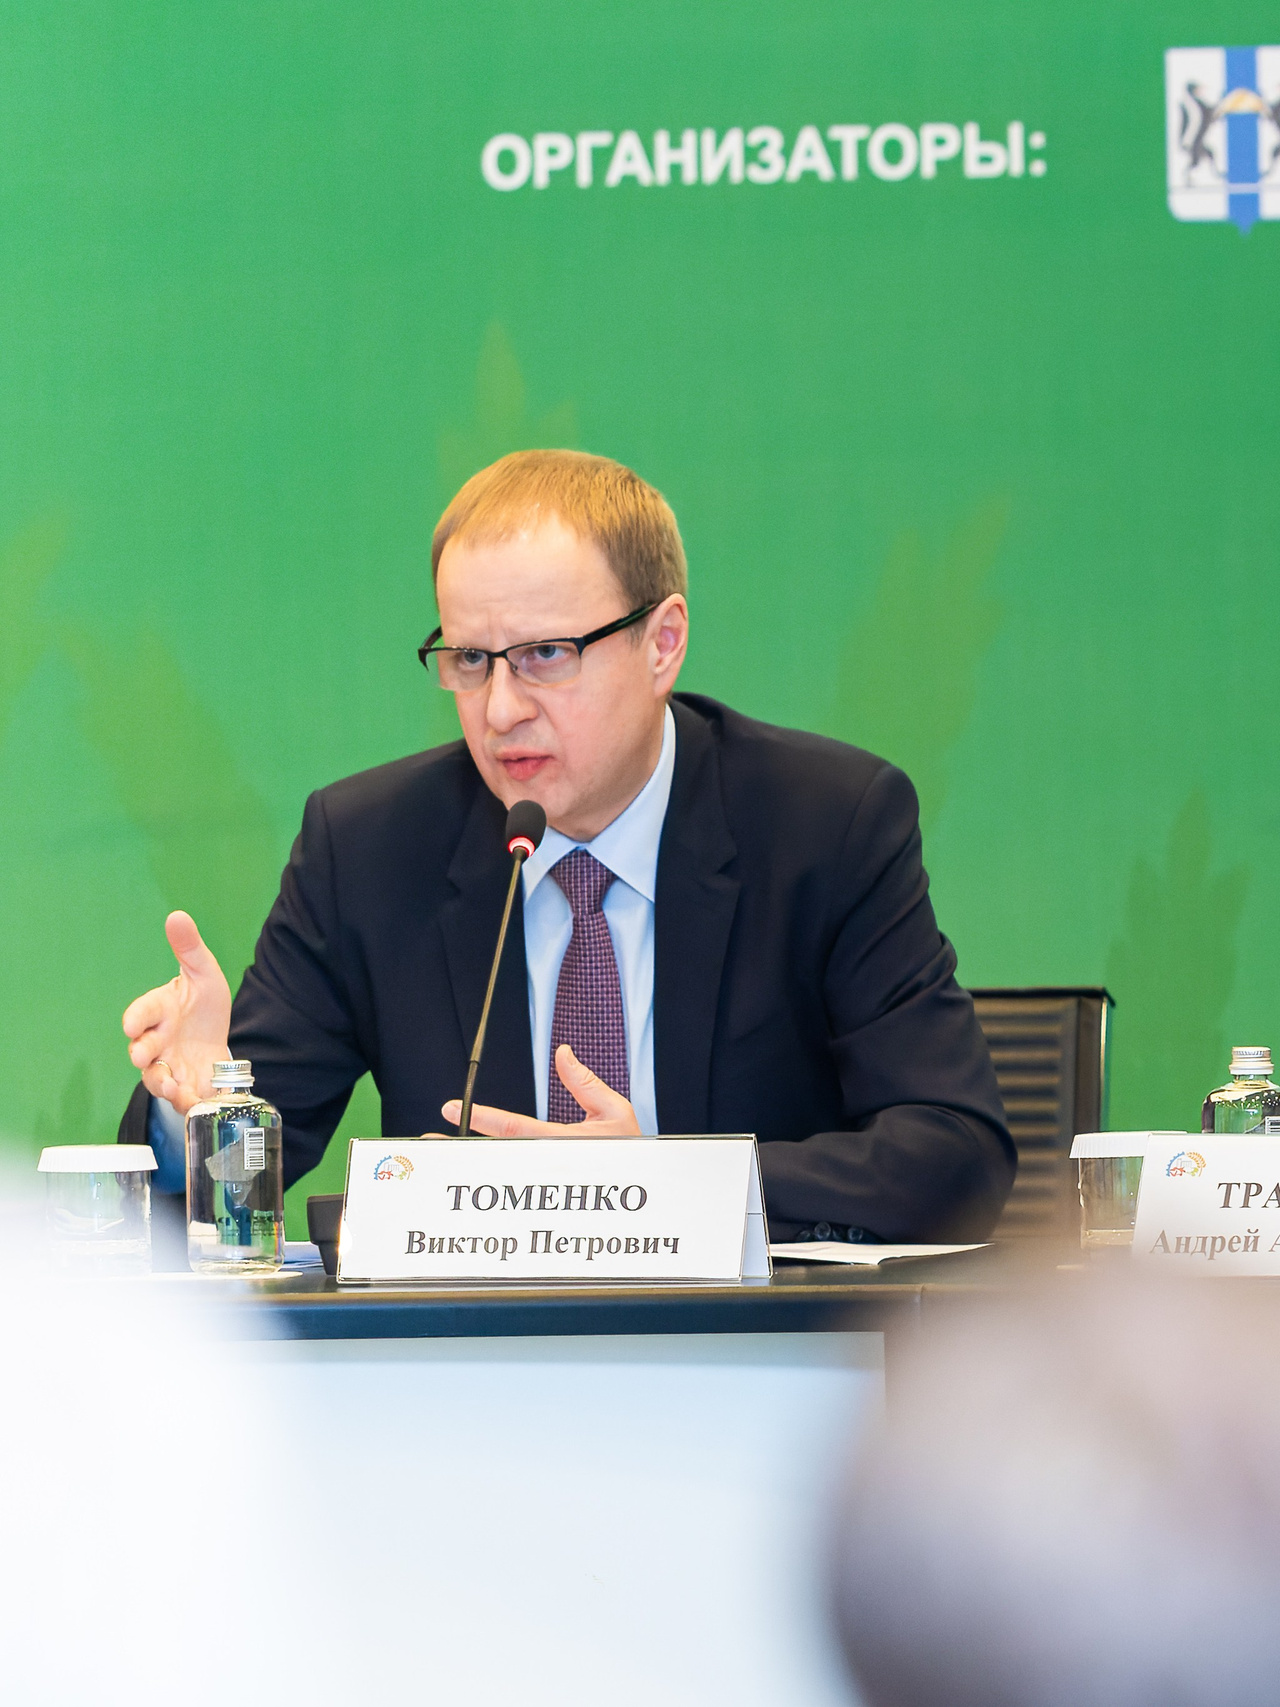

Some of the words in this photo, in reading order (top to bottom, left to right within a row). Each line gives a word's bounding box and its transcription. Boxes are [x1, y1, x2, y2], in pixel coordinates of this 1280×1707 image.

[481, 120, 1048, 192] ОРГАНИЗАТОРЫ:
[446, 1184, 648, 1211] ТОМЕНКО
[404, 1229, 519, 1261] Виктор
[527, 1229, 681, 1261] Петрович
[1150, 1228, 1260, 1261] Андрей
